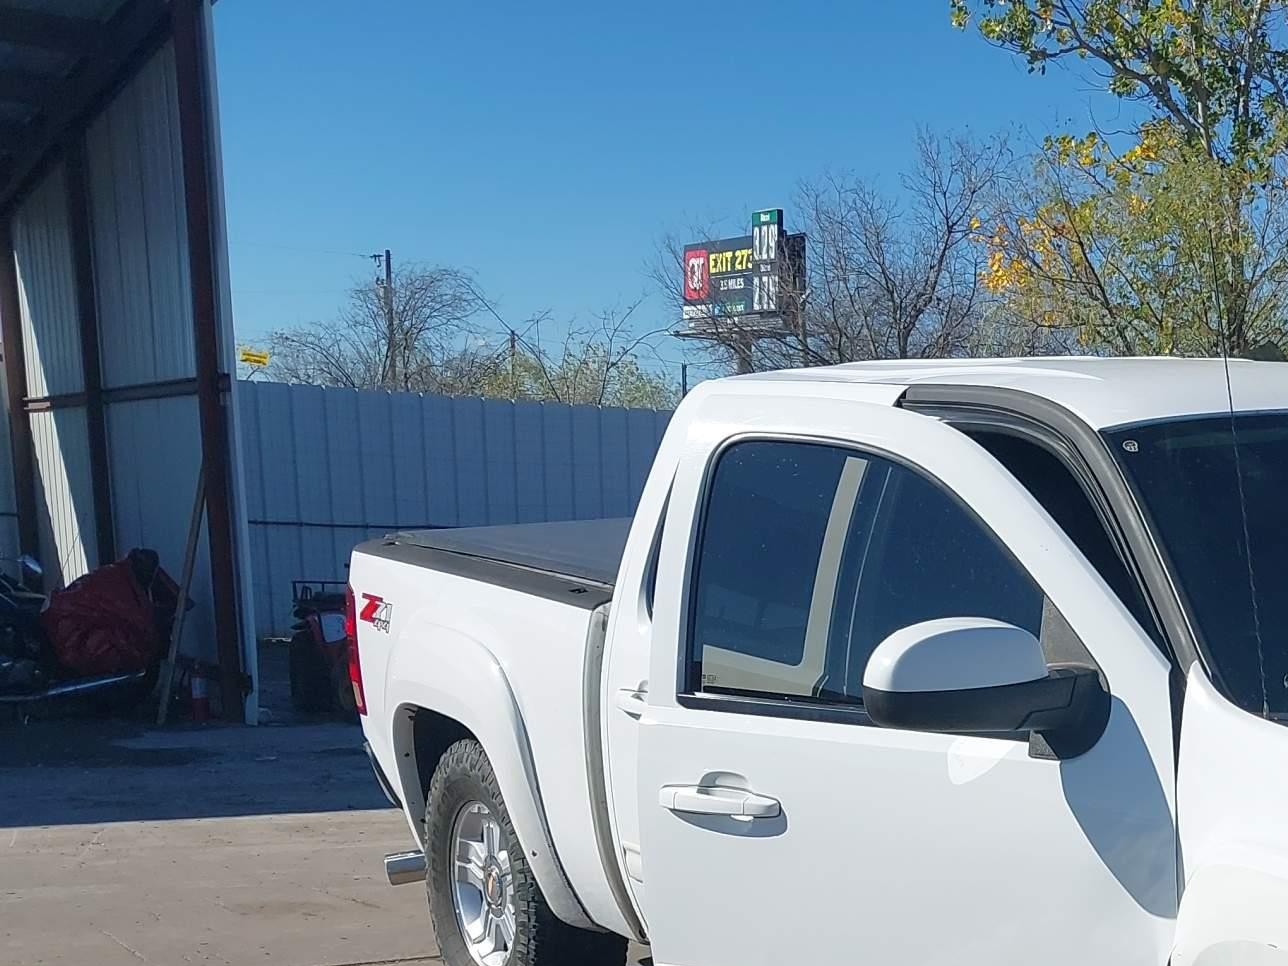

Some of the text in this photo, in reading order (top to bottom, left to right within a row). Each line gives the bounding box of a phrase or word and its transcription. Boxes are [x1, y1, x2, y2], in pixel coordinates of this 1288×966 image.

[709, 252, 733, 274] EXIT
[728, 278, 745, 289] MILES
[360, 592, 392, 624] Z71
